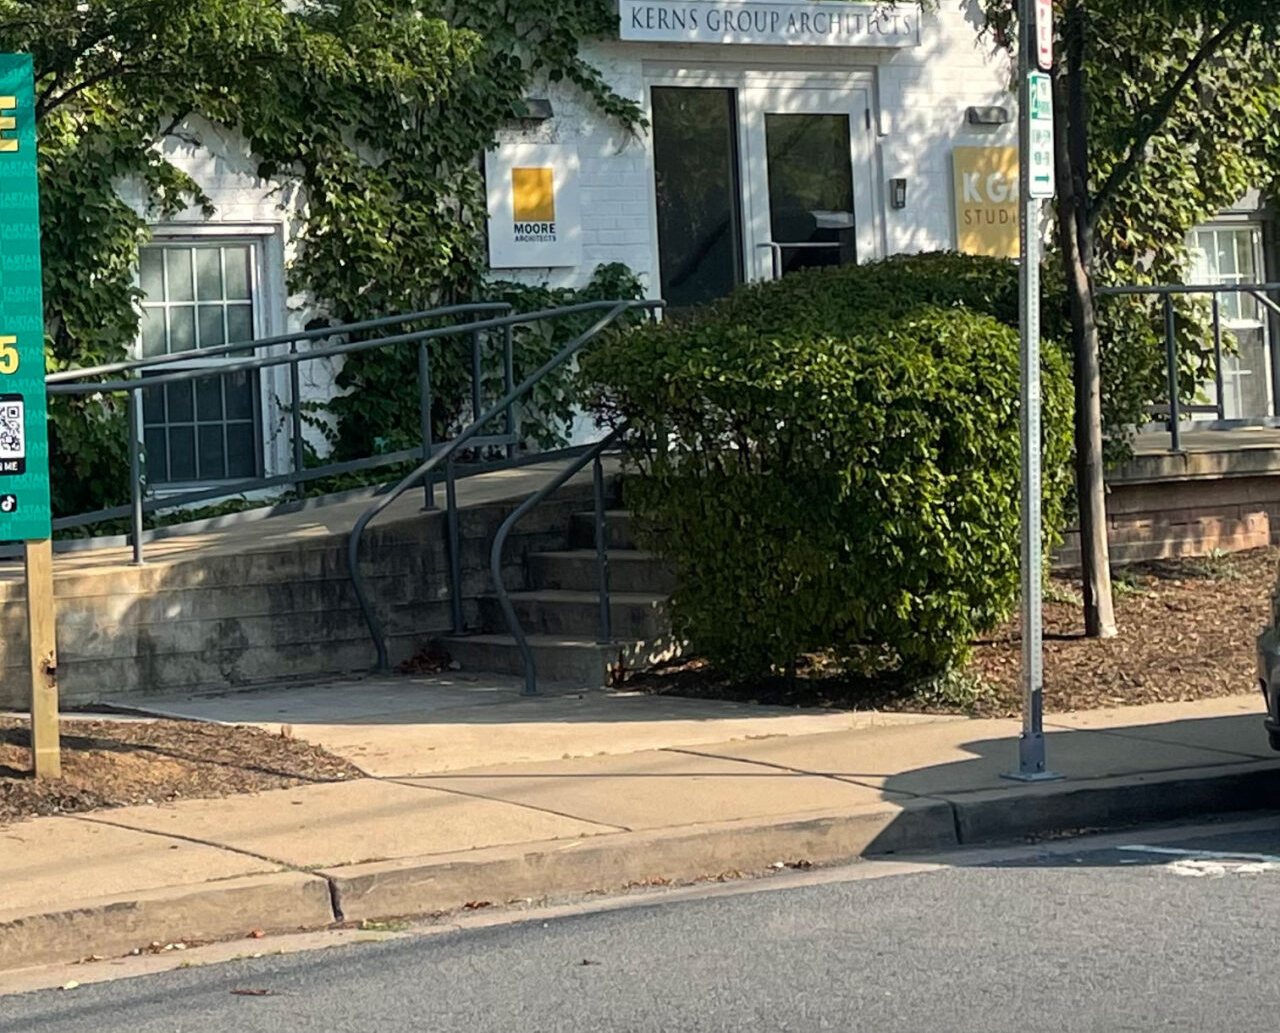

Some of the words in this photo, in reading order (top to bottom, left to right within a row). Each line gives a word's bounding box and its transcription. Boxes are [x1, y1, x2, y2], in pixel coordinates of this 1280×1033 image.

[631, 6, 699, 30] KERNS
[706, 8, 780, 33] GROUP
[786, 11, 911, 36] ARCHITECTS
[964, 209, 1016, 225] STUDI
[514, 223, 556, 234] MOORE
[515, 234, 556, 242] ARCHITECTS
[4, 461, 18, 471] ME
